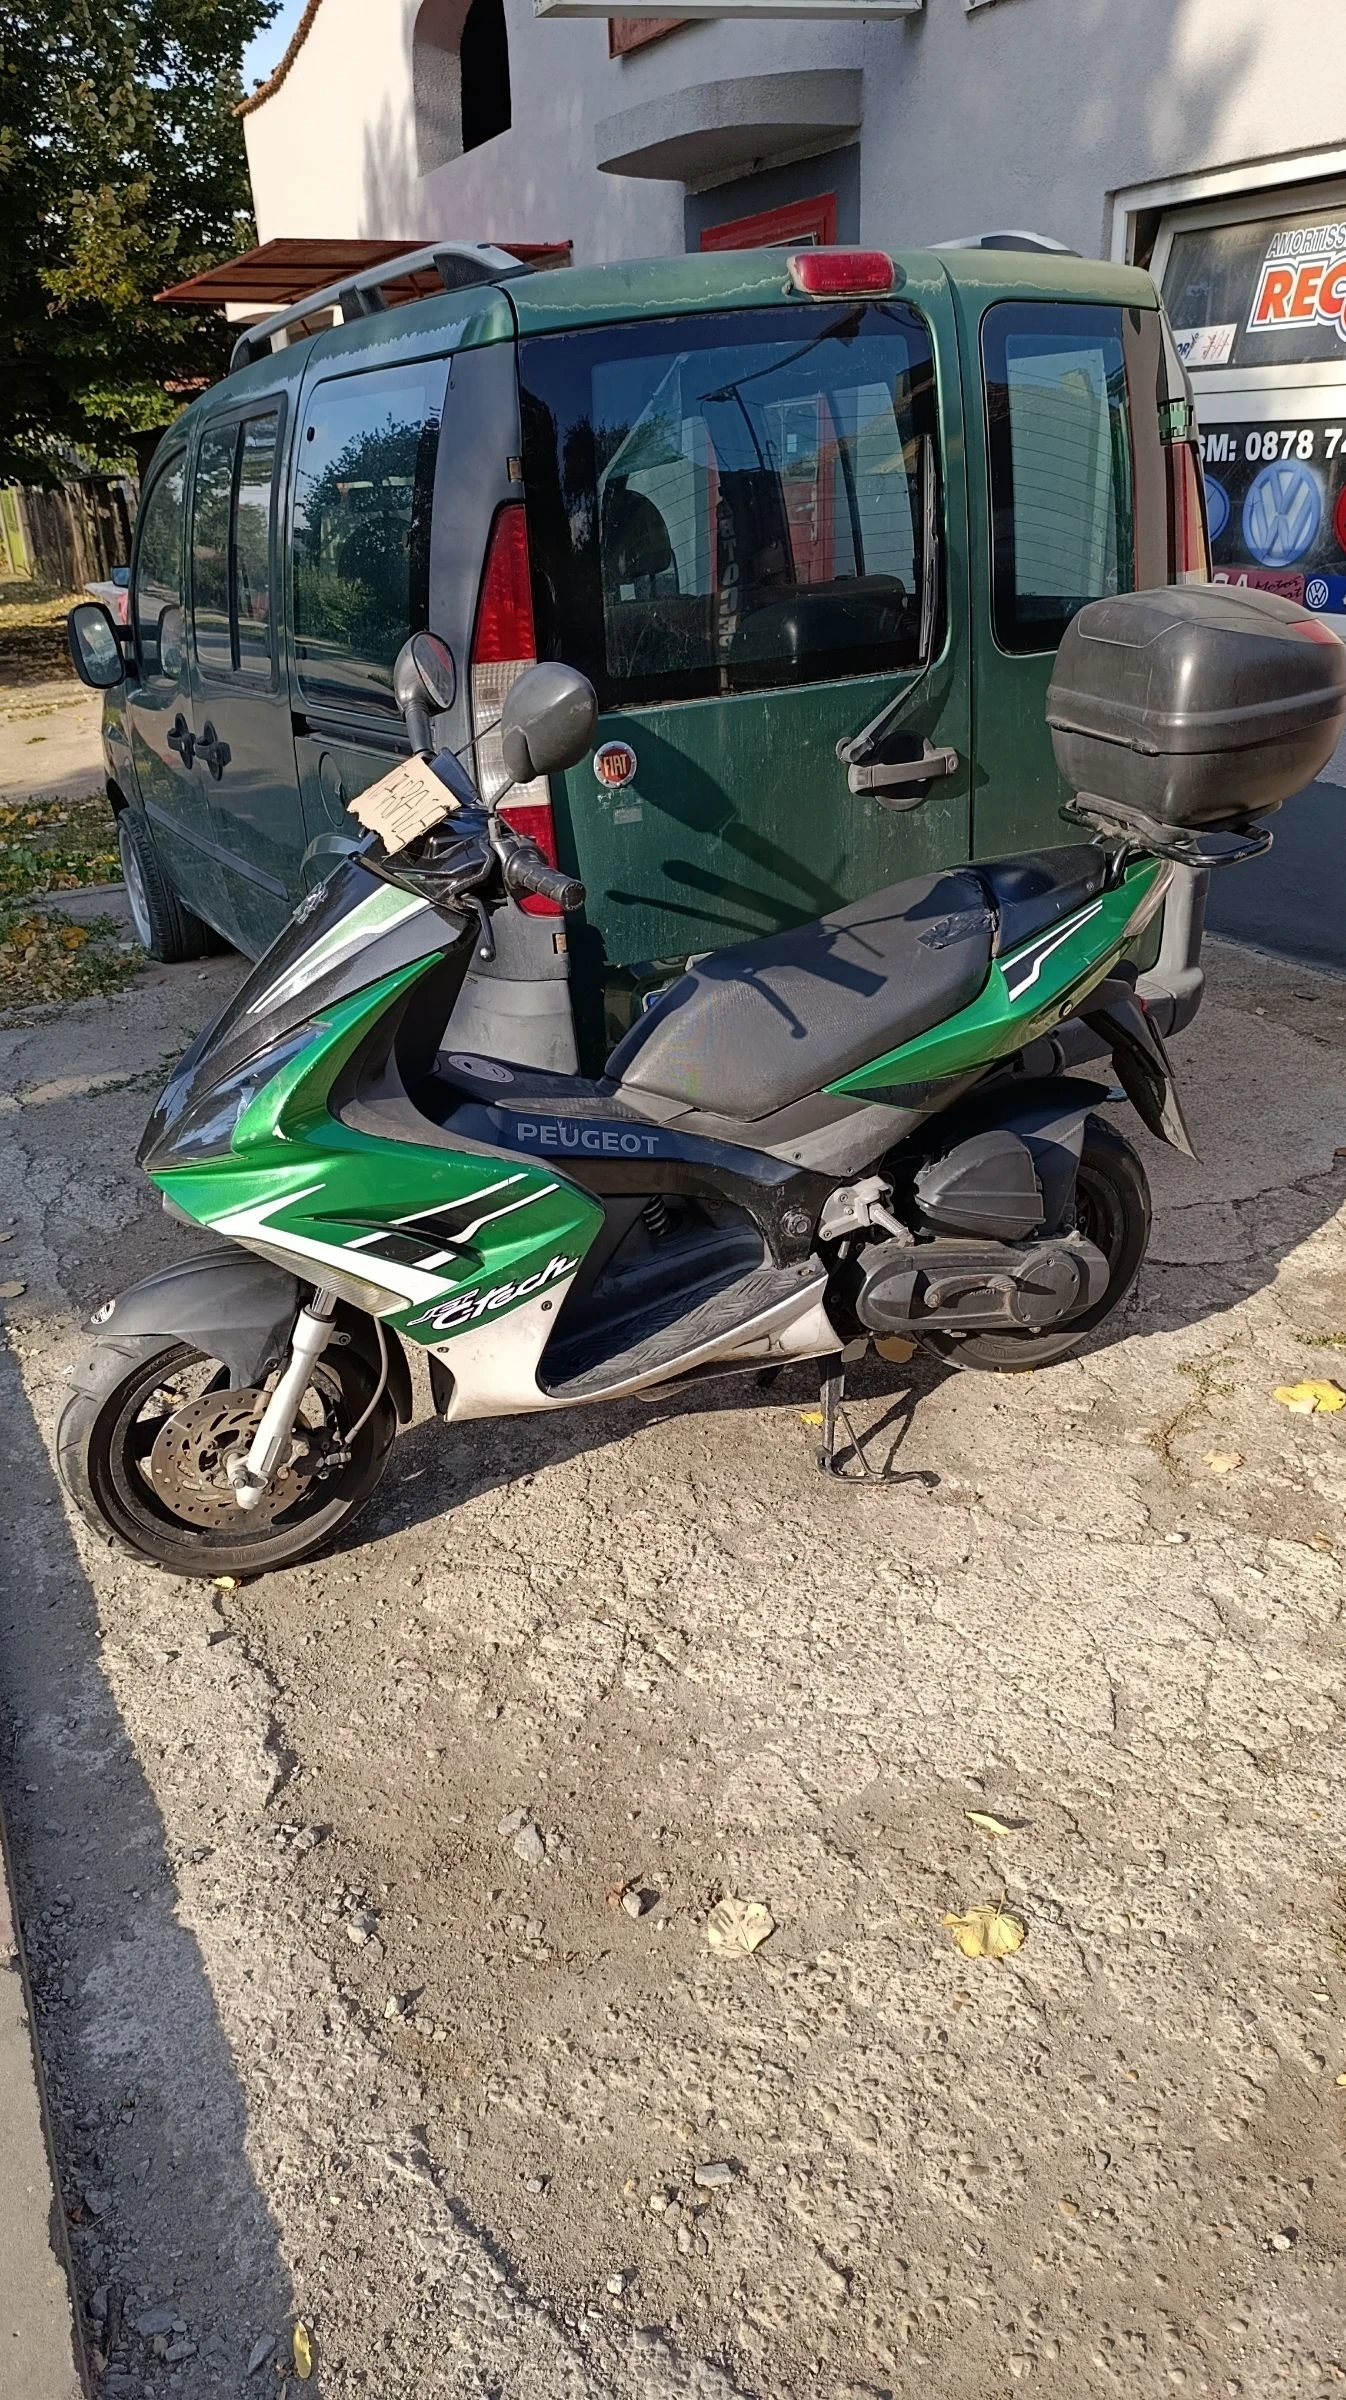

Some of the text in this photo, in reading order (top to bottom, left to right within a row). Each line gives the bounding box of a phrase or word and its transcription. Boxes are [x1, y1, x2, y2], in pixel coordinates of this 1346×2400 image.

[1244, 429, 1314, 461] 0878
[603, 753, 628, 777] FIAT
[517, 1121, 660, 1155] PEUGEOT
